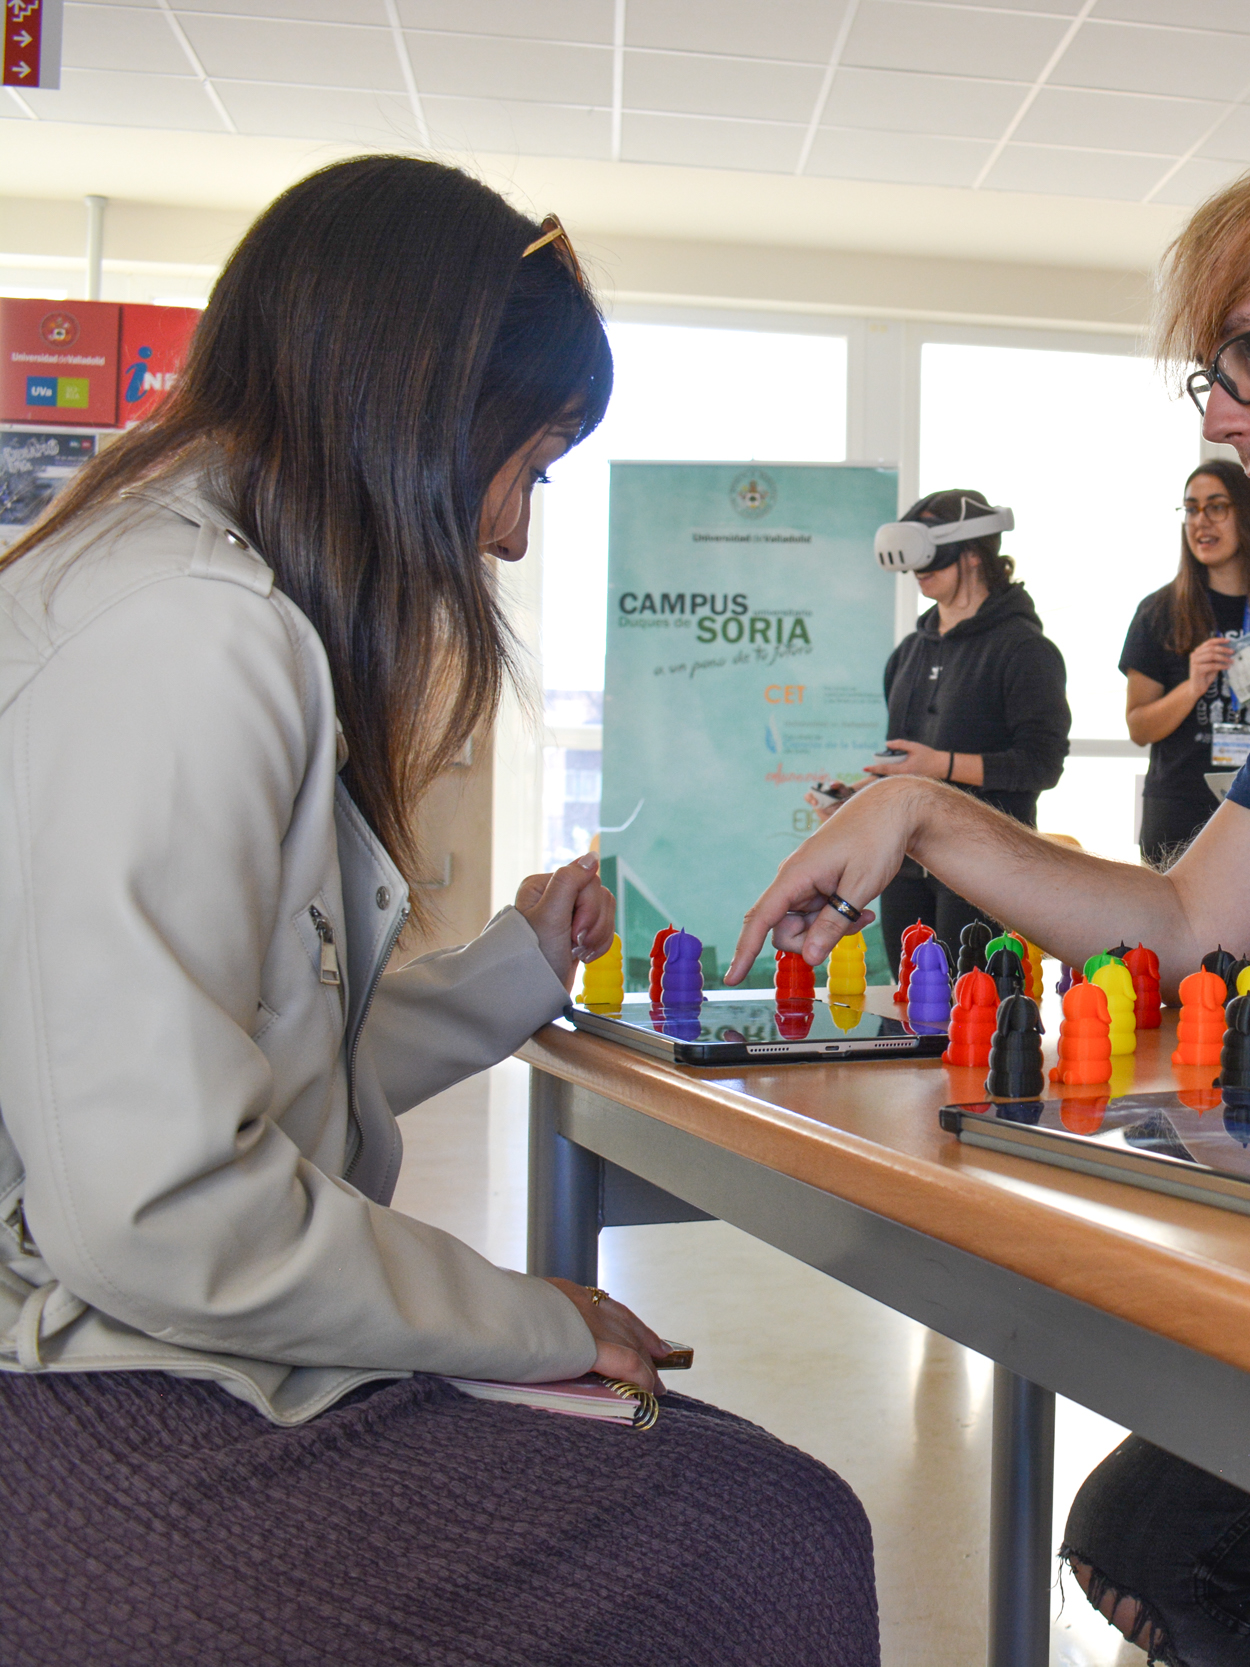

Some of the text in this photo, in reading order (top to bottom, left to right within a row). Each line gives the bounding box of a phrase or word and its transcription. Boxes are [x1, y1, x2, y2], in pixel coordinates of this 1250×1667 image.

[11, 352, 58, 364] Universidad
[68, 354, 106, 366] Valladolid
[31, 386, 52, 397] UVa
[619, 591, 748, 616] CAMPUS
[618, 616, 692, 630] Duques de
[696, 616, 811, 645] SORIA
[764, 684, 807, 705] CET
